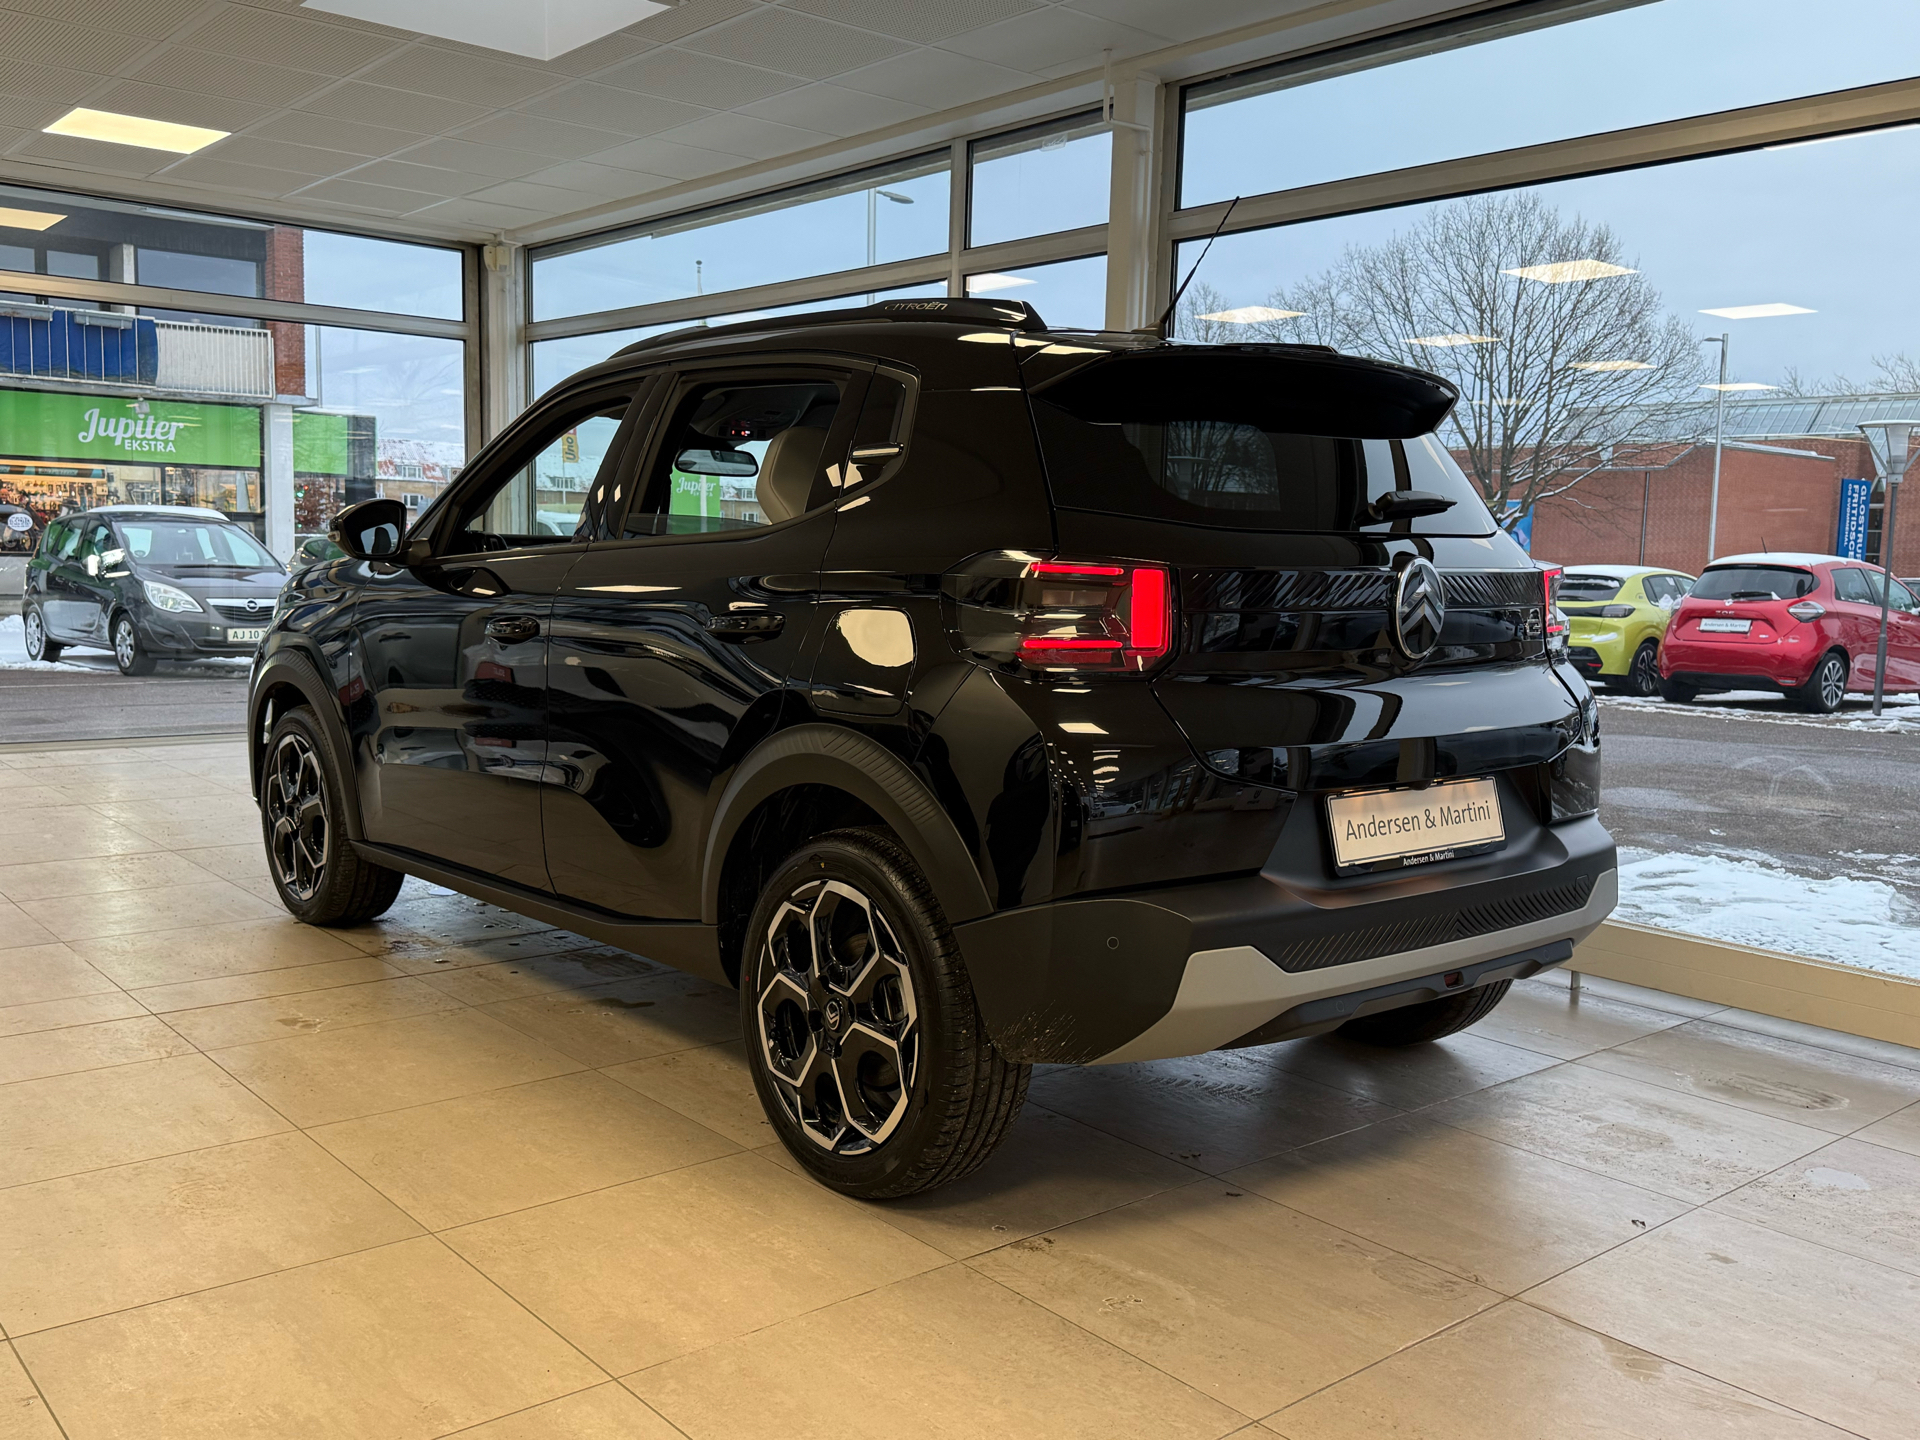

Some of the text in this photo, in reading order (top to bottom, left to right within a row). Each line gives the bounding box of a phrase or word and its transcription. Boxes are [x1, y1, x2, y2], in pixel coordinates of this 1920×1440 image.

[78, 408, 184, 446] Jupiter
[124, 439, 176, 453] EKSTRA
[676, 476, 717, 495] Jupier
[232, 630, 245, 640] AJ
[249, 630, 260, 639] 10
[1345, 800, 1491, 841] Andersen & Martini
[1403, 855, 1429, 866] Andersen
[1435, 850, 1455, 860] Martini
